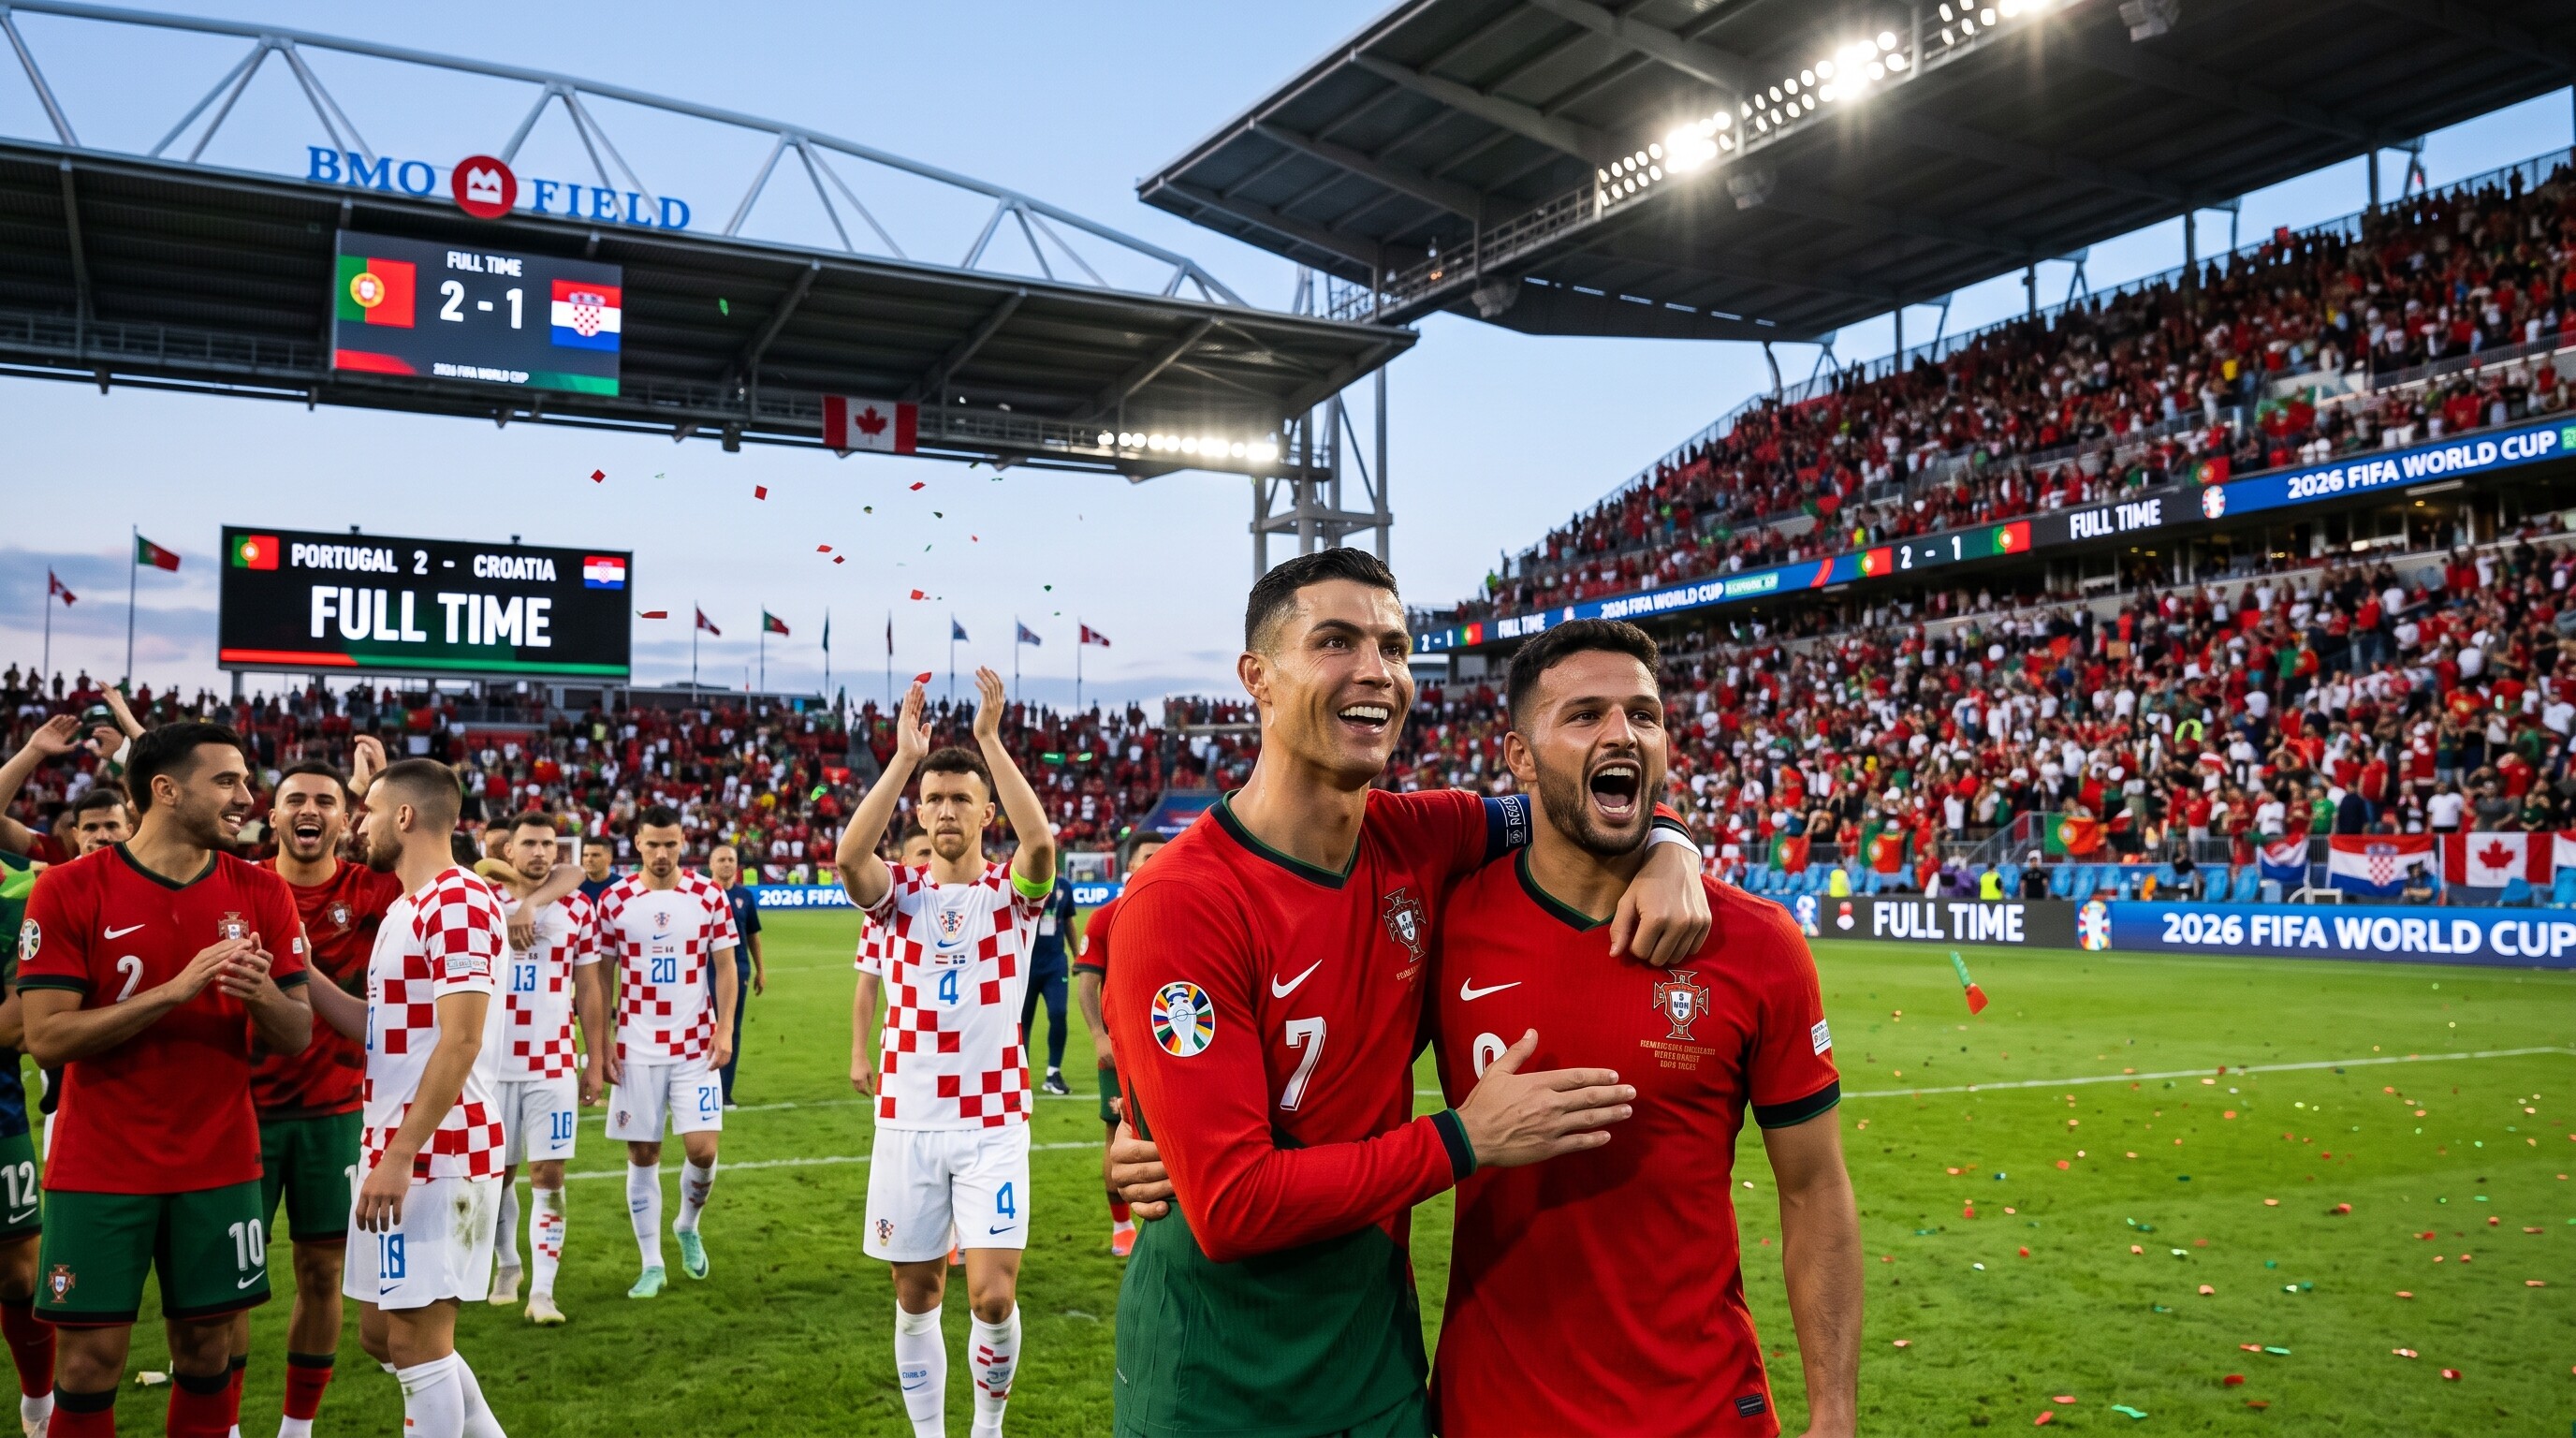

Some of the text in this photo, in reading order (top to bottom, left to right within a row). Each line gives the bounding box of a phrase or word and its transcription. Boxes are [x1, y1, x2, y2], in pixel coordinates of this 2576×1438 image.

[307, 146, 691, 230] BMO FIELD
[447, 250, 522, 277] FULL TIME
[439, 280, 464, 323] 2
[506, 287, 523, 330] 1
[2287, 468, 2345, 500] 2026
[2348, 460, 2401, 489] FIFA
[2401, 441, 2498, 478] WORLD
[2500, 430, 2557, 460] CUP
[2070, 498, 2161, 540] FULL TIME
[291, 542, 398, 573] PORTUGAL
[413, 550, 428, 575] 2
[474, 554, 557, 581] CROATIA
[1900, 545, 1912, 569] 2
[1951, 536, 1961, 561] 1
[311, 585, 552, 647] FULL TIME
[1629, 595, 1653, 614] FIFA
[1653, 587, 1698, 609] WORLD
[1698, 581, 1724, 602] CUP
[1498, 613, 1545, 638] FULL TIME
[758, 888, 846, 906] 2026 FIFA
[1073, 888, 1109, 903] CUP
[1873, 901, 2025, 943] FULL TIME
[2161, 912, 2576, 958] 2026 FIFA WORLD CUP
[116, 955, 143, 1003] 2
[513, 965, 536, 991] 13
[651, 958, 676, 983] 20
[938, 969, 959, 1005] 4
[1280, 1017, 1326, 1111] 7
[1, 1160, 38, 1210] 12
[996, 1181, 1016, 1220] 4
[227, 1218, 266, 1271] 10
